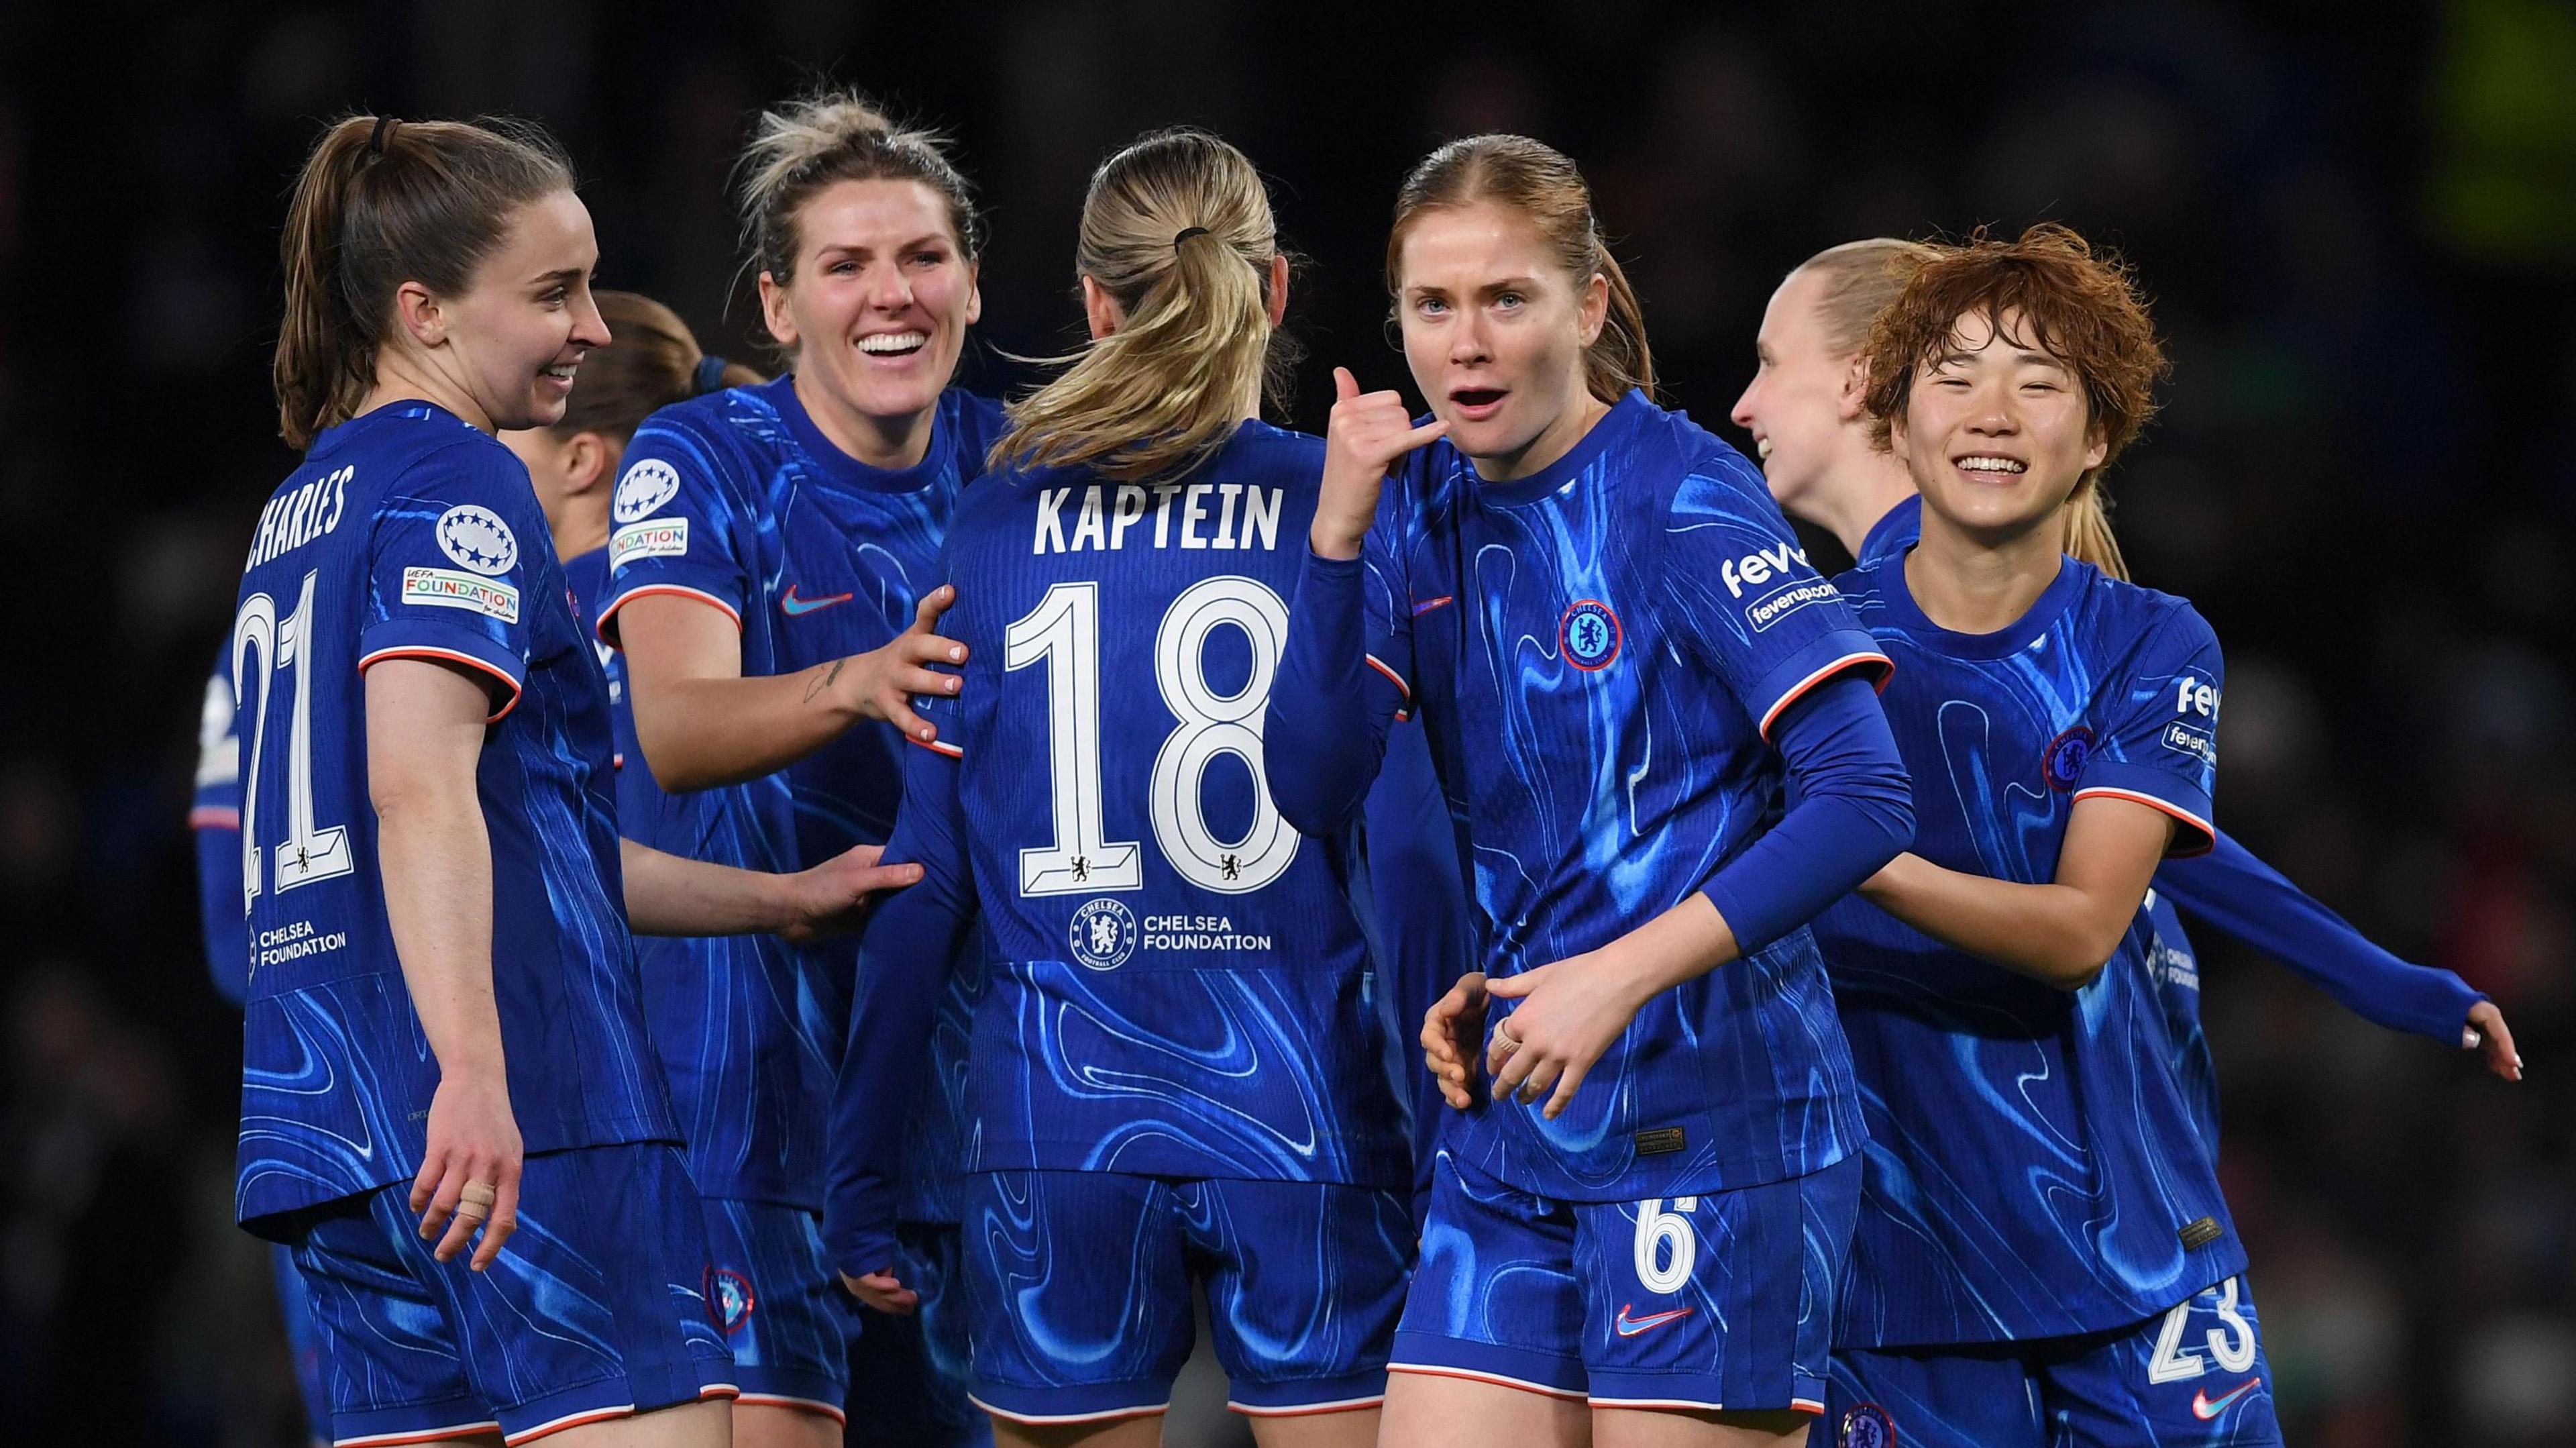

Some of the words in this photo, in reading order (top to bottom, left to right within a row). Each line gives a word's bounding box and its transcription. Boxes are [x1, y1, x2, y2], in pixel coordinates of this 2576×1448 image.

[245, 465, 354, 573] CHARLES
[1033, 484, 1283, 554] KAPTEIN
[407, 570, 433, 578] UEFA
[406, 579, 516, 611] FOUNDATION
[1571, 605, 1607, 619] CHELSEA
[233, 568, 354, 921] 21
[1005, 575, 1301, 897] 18
[1081, 901, 1124, 917] CHELSEA
[1144, 916, 1232, 931] CHELSEA
[260, 921, 314, 947] CHELSEA
[261, 931, 346, 967] FOUNDATION
[1144, 935, 1271, 950] FOUNDATION
[1081, 953, 1110, 967] FOOTBALL
[1634, 1196, 1697, 1294] 6
[2148, 1276, 2256, 1385] 23
